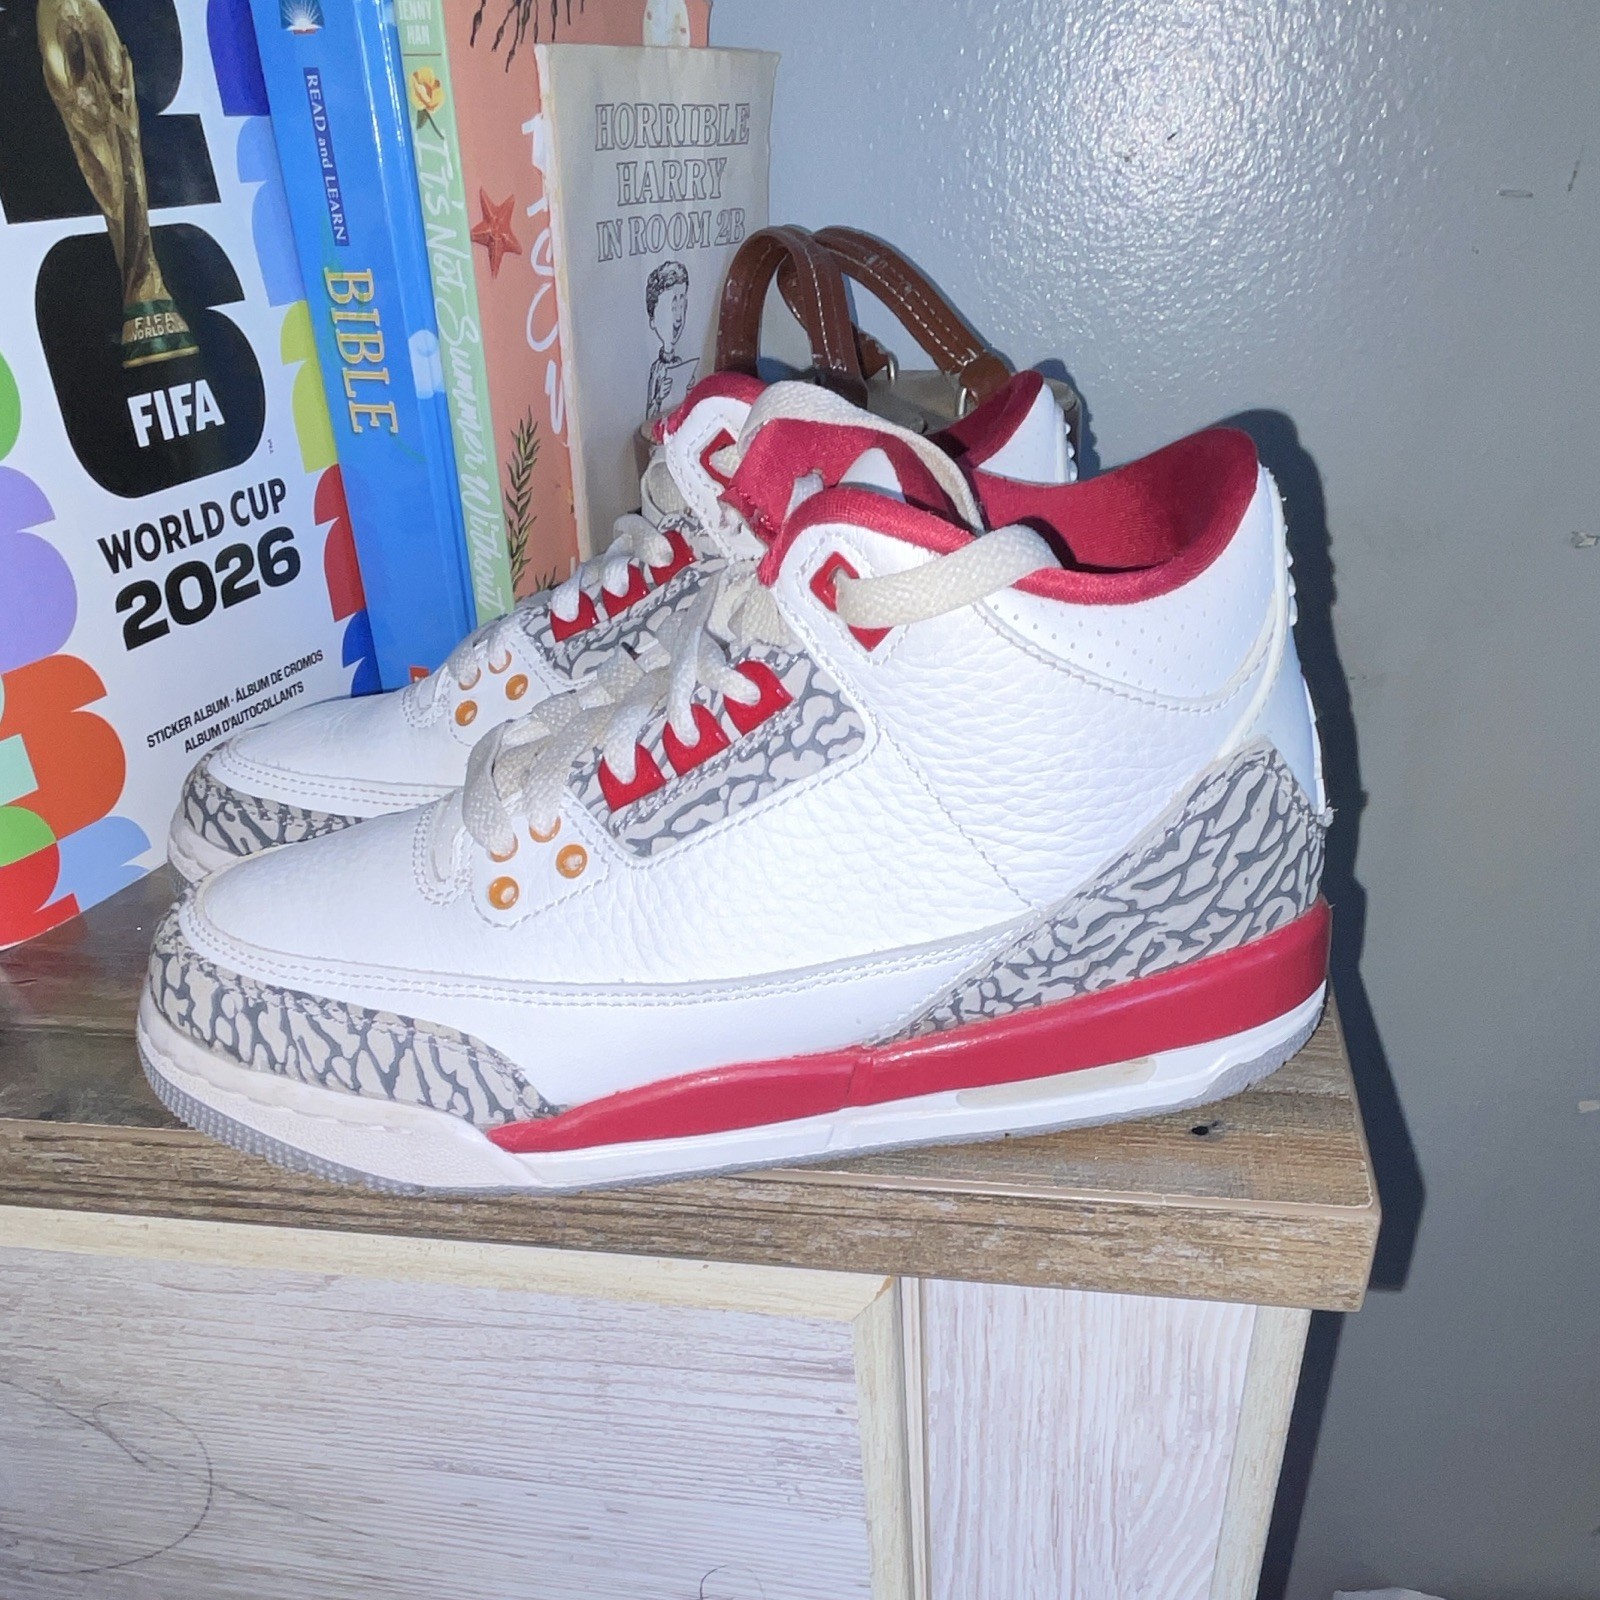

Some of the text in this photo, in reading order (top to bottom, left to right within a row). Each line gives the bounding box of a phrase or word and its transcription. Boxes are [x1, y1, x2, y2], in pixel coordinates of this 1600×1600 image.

[306, 74, 347, 240] READ and LEARN
[595, 102, 750, 151] HORRIBLE
[616, 157, 728, 207] HARRY
[426, 222, 471, 292] Not
[596, 207, 746, 262] IN ROOM 2B
[134, 312, 174, 329] FIFA
[323, 266, 399, 434] BIBLE
[127, 379, 225, 449] FIFA
[434, 297, 488, 470] Summer
[97, 478, 287, 574] WORLD CUP
[460, 472, 506, 613] Without
[115, 526, 302, 652] 2026
[146, 715, 193, 748] STICKER
[194, 695, 230, 725] ALBUM
[235, 675, 270, 703] ÁLBUM
[270, 669, 284, 685] DE
[283, 649, 324, 678] CROMOS
[184, 681, 305, 753] ALBUM D'AUTOCOLLANTS
